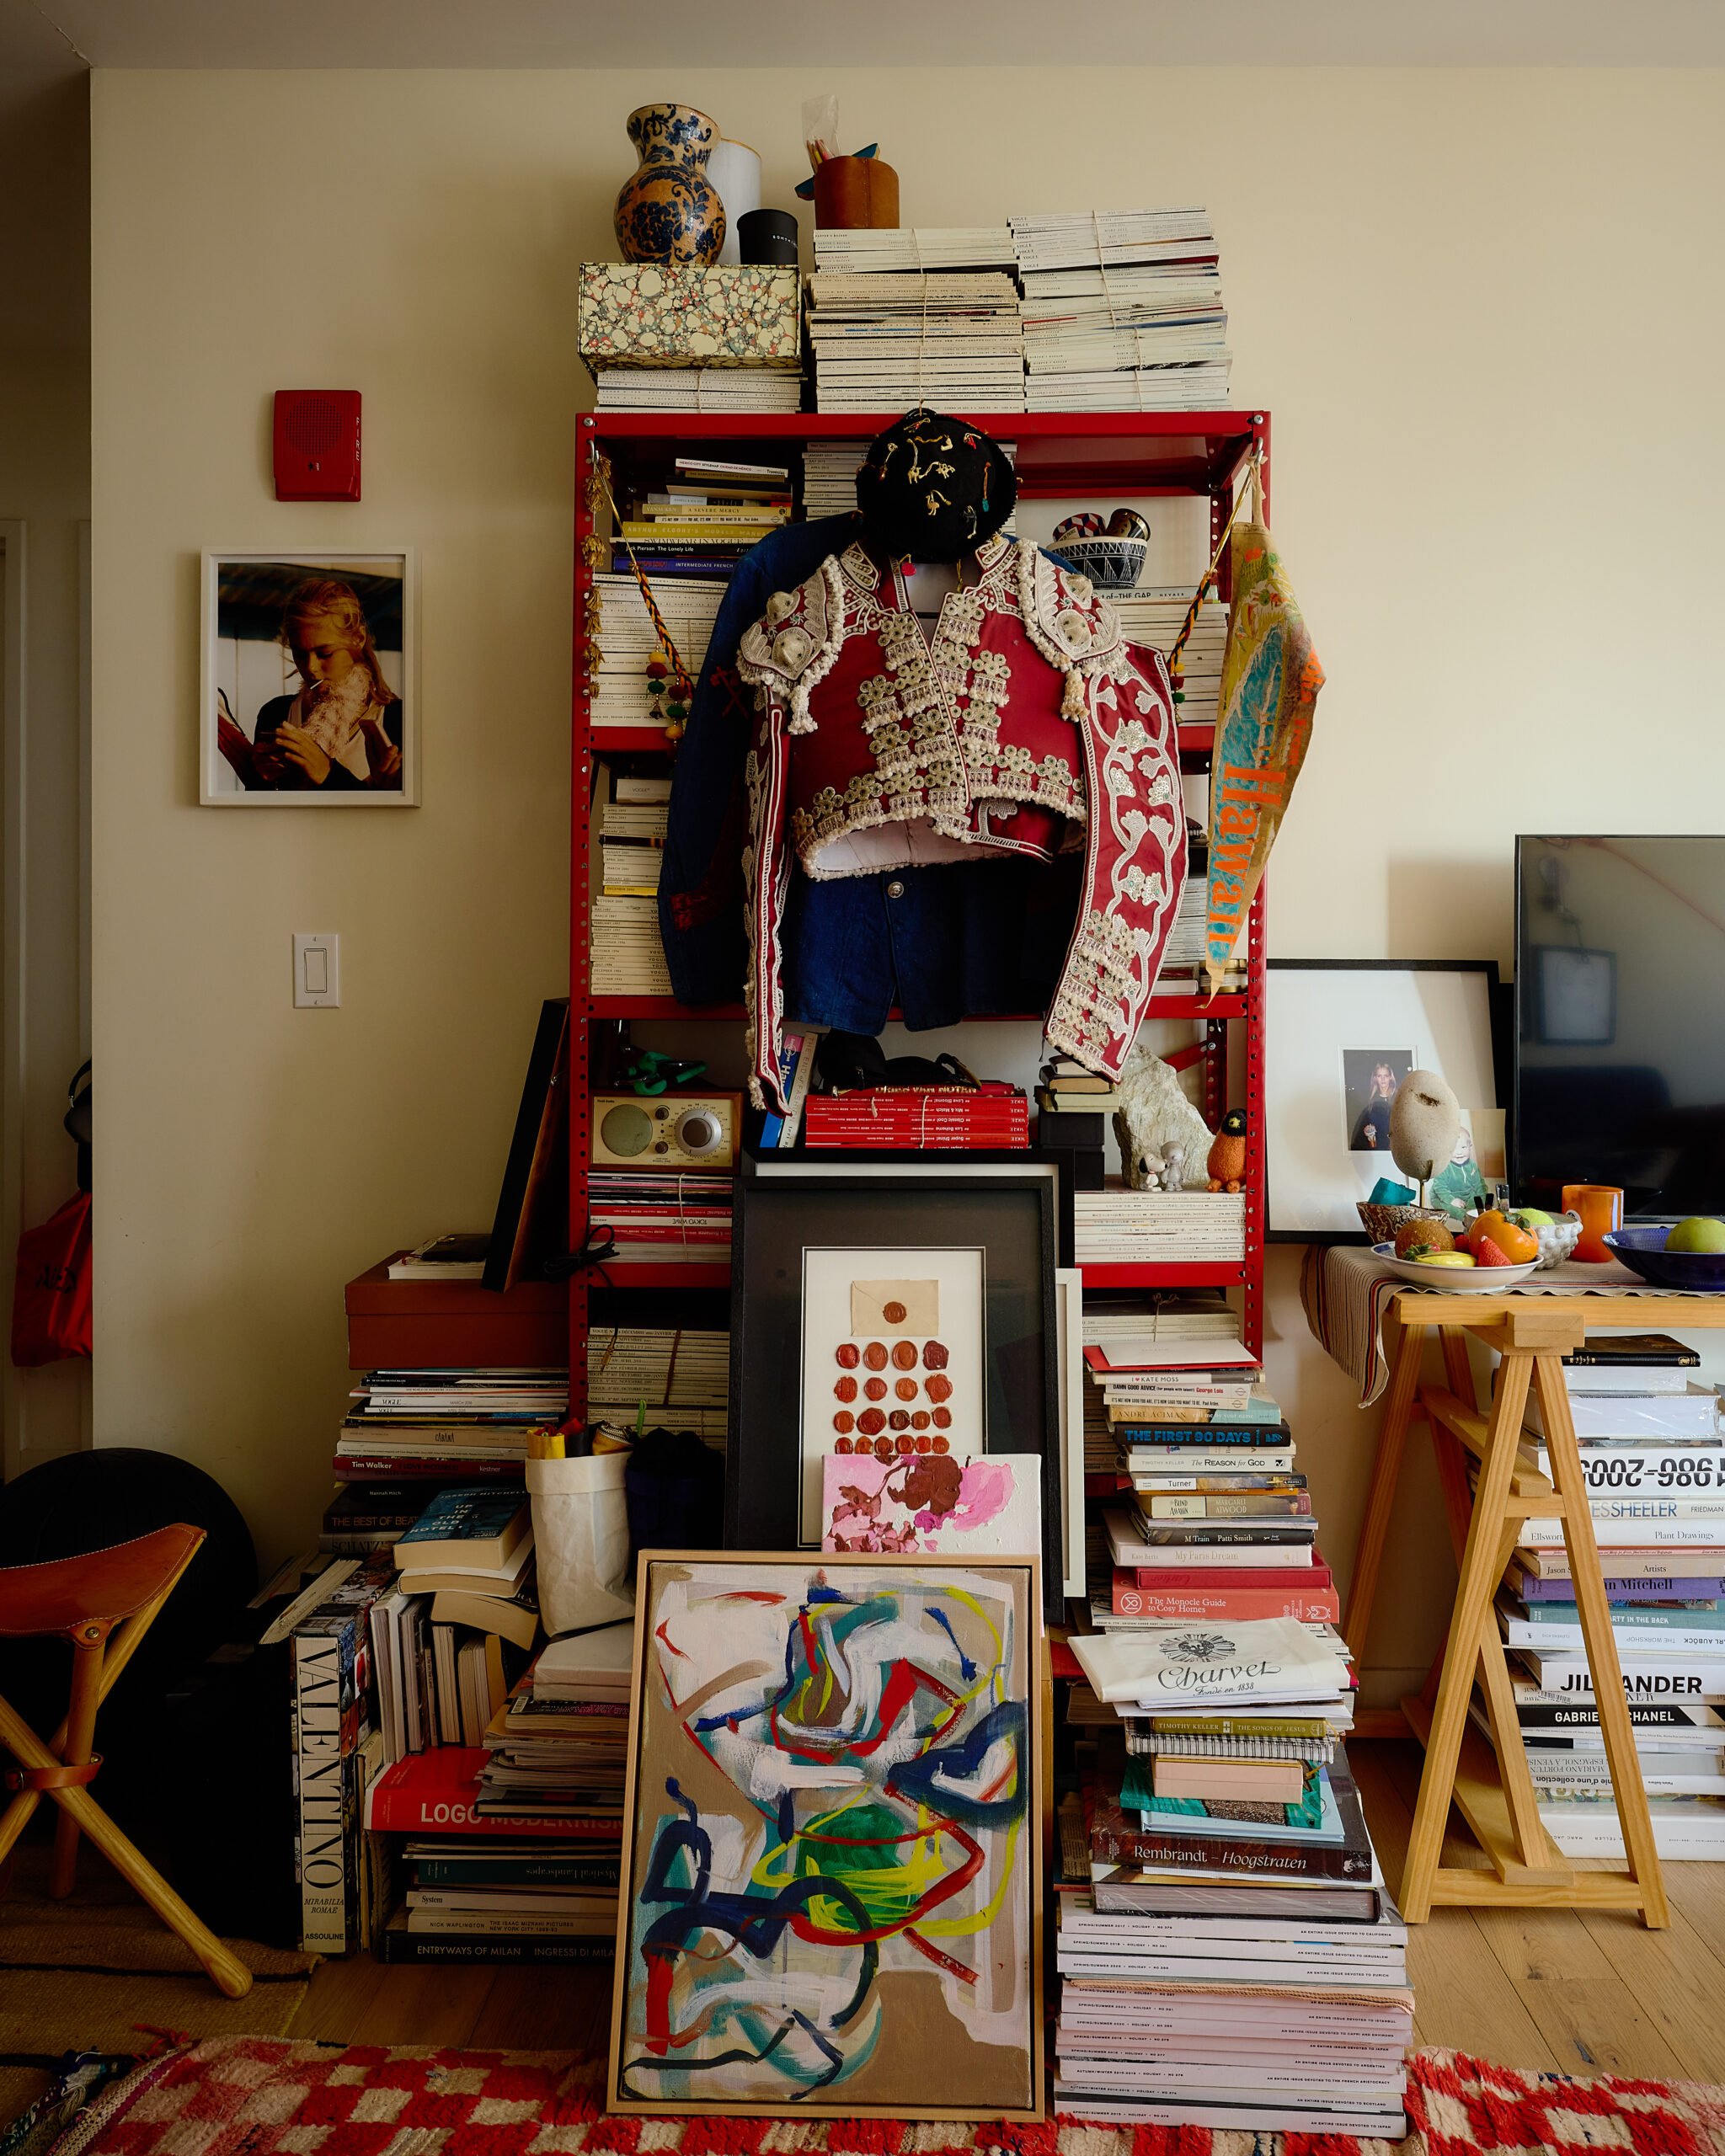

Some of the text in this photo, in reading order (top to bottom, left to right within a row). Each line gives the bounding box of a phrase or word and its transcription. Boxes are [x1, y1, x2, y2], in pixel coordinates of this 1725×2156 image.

[1125, 1430, 1251, 1443] THE FIRST 90 DAYS
[1581, 1458, 1725, 1487] 1986-200
[331, 1518, 350, 1526] THE
[353, 1517, 377, 1526] BEST
[379, 1517, 393, 1526] OF
[1530, 1531, 1714, 1541] Ellswort Plant Drawings
[1175, 1551, 1186, 1561] My
[1189, 1551, 1210, 1560] Paris
[1211, 1551, 1239, 1560] Dream
[1546, 1566, 1566, 1575] Jason
[1621, 1578, 1673, 1590] Mitchell
[1167, 1598, 1199, 1606] Monocle
[1157, 1661, 1281, 1690] Charvet
[1623, 1676, 1702, 1694] ANDER
[1555, 1711, 1599, 1722] GABRIE
[297, 1644, 344, 1890] VALENTINO
[421, 1802, 482, 1824] LOGO
[1135, 1846, 1306, 1870] Rembrandt Hoogstraten
[422, 1896, 443, 1904] System
[417, 1946, 472, 1955] ENTRYWAYS
[477, 1946, 488, 1956] OF
[490, 1947, 521, 1956] MILAN
[534, 1948, 577, 1956] INGRESSI
[579, 1948, 589, 1956] DI
